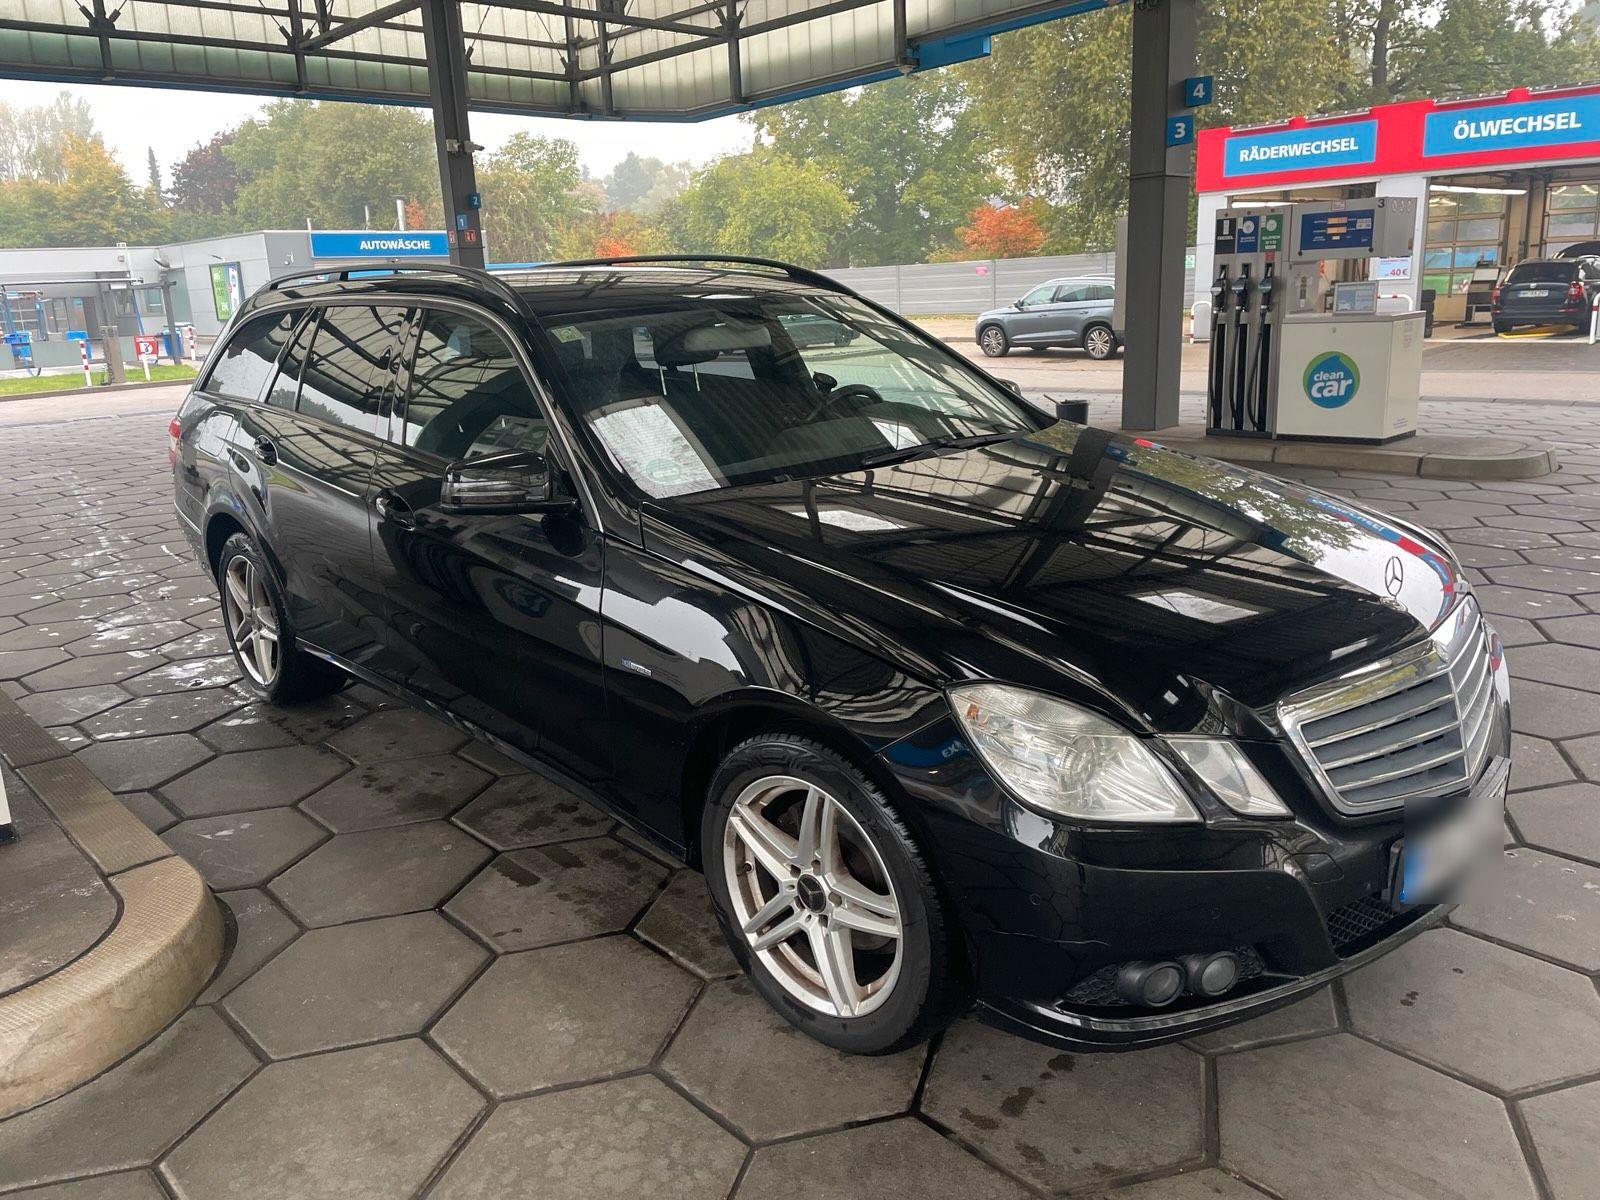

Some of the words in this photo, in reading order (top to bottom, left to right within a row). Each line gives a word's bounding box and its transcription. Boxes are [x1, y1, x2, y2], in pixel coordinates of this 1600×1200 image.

[1193, 83, 1205, 98] 4
[1174, 122, 1186, 139] 3
[1453, 112, 1582, 140] ÖLWECHSEL
[1239, 138, 1359, 162] RÄDERWECHSEL
[473, 196, 479, 205] 2
[1378, 199, 1385, 208] 3
[459, 218, 464, 227] 1
[360, 239, 431, 250] AUTOWÄSCHE
[1314, 371, 1344, 381] clean
[1311, 379, 1353, 398] car
